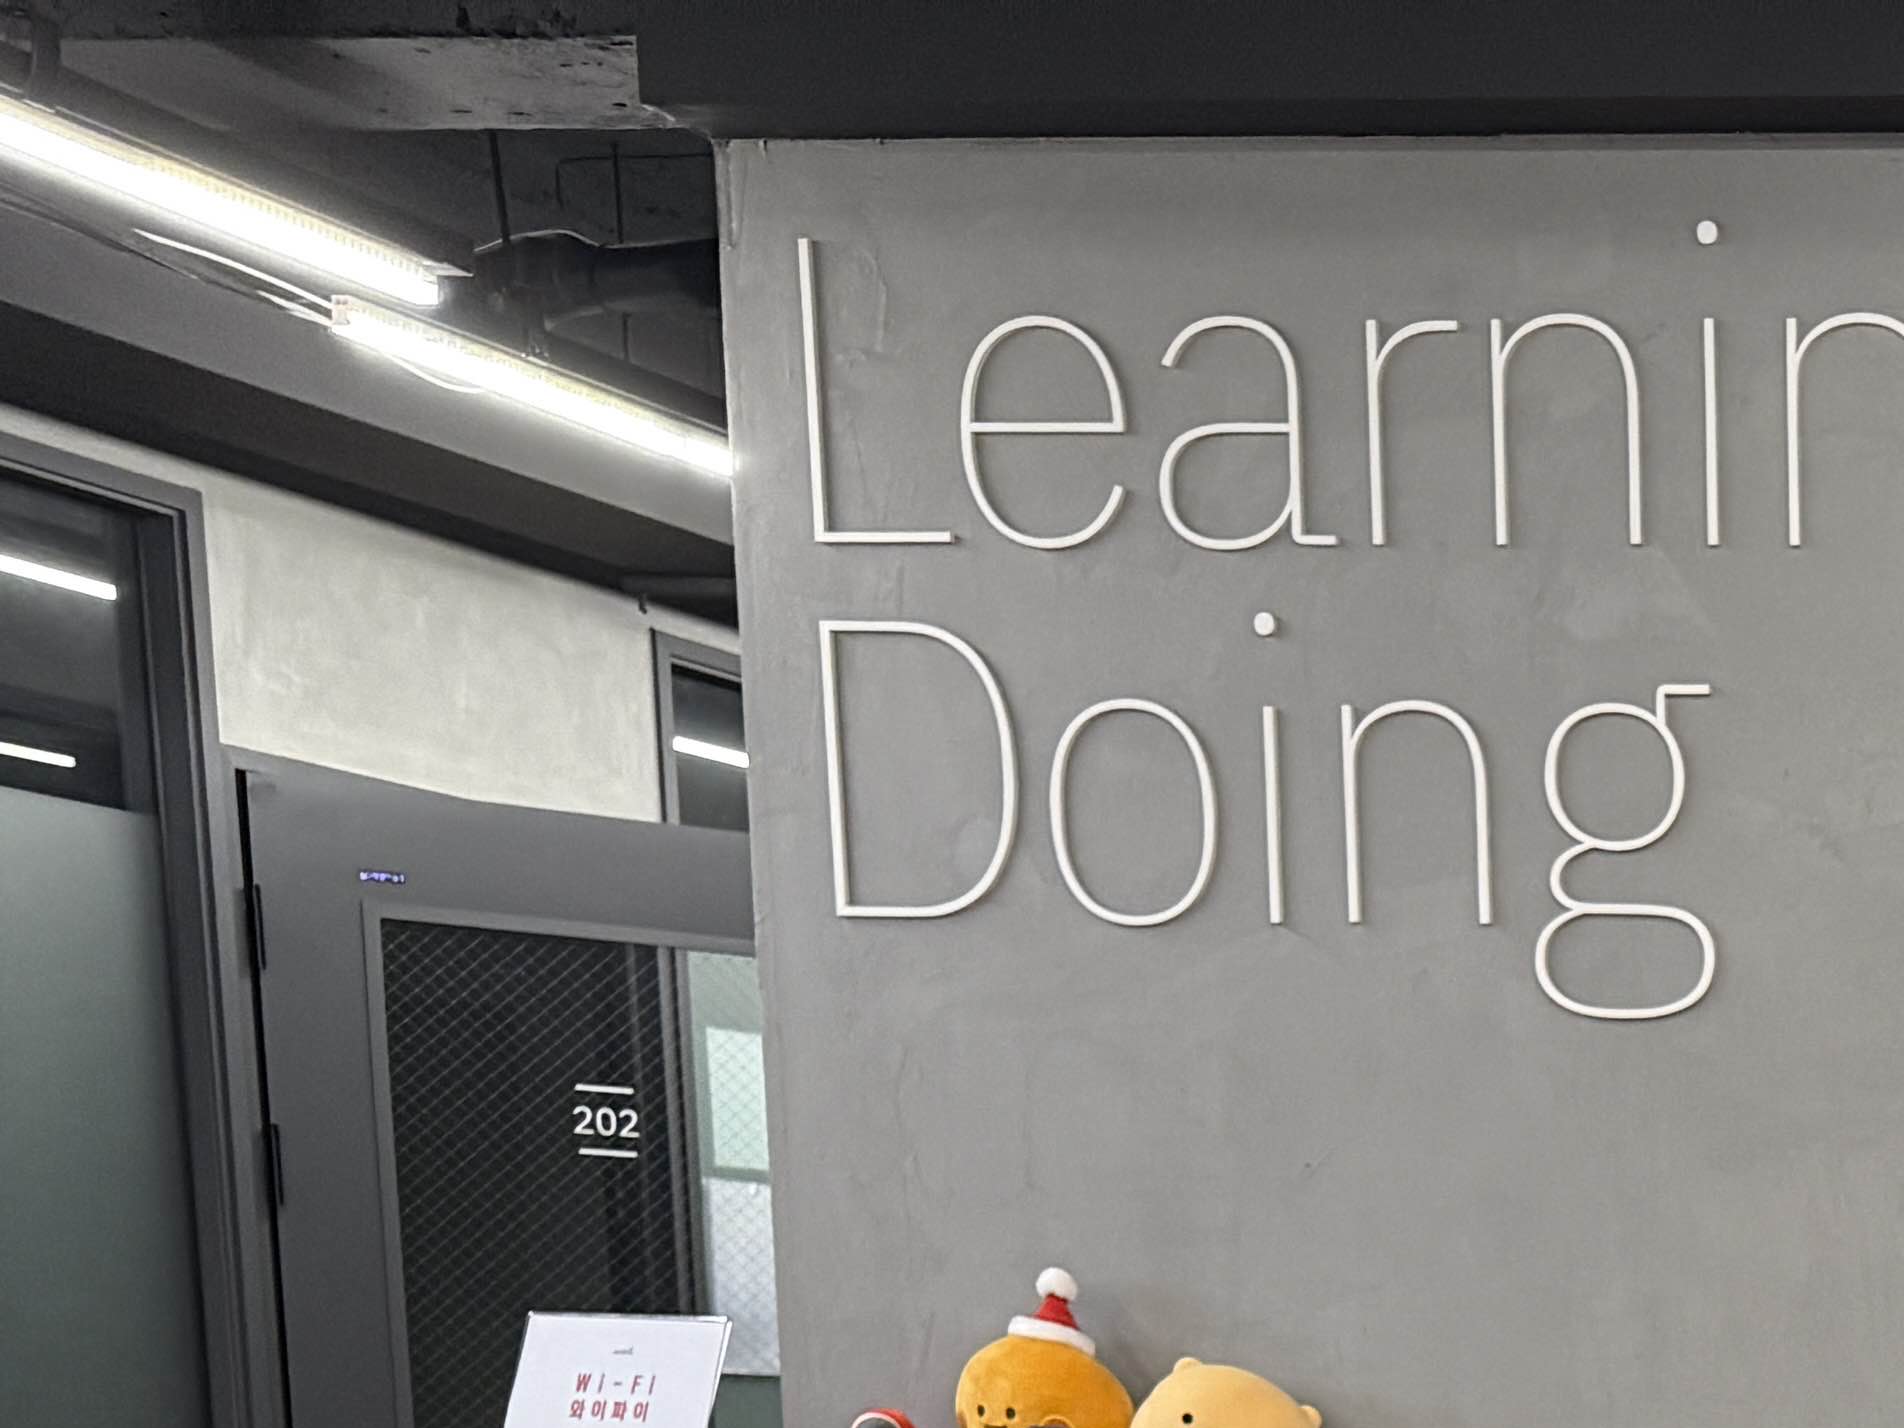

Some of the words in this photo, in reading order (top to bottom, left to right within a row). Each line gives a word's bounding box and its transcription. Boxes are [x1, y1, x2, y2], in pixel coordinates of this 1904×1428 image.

[819, 611, 1715, 1019] Doing
[573, 1106, 640, 1137] 202
[569, 1398, 649, 1422] 와이파이
